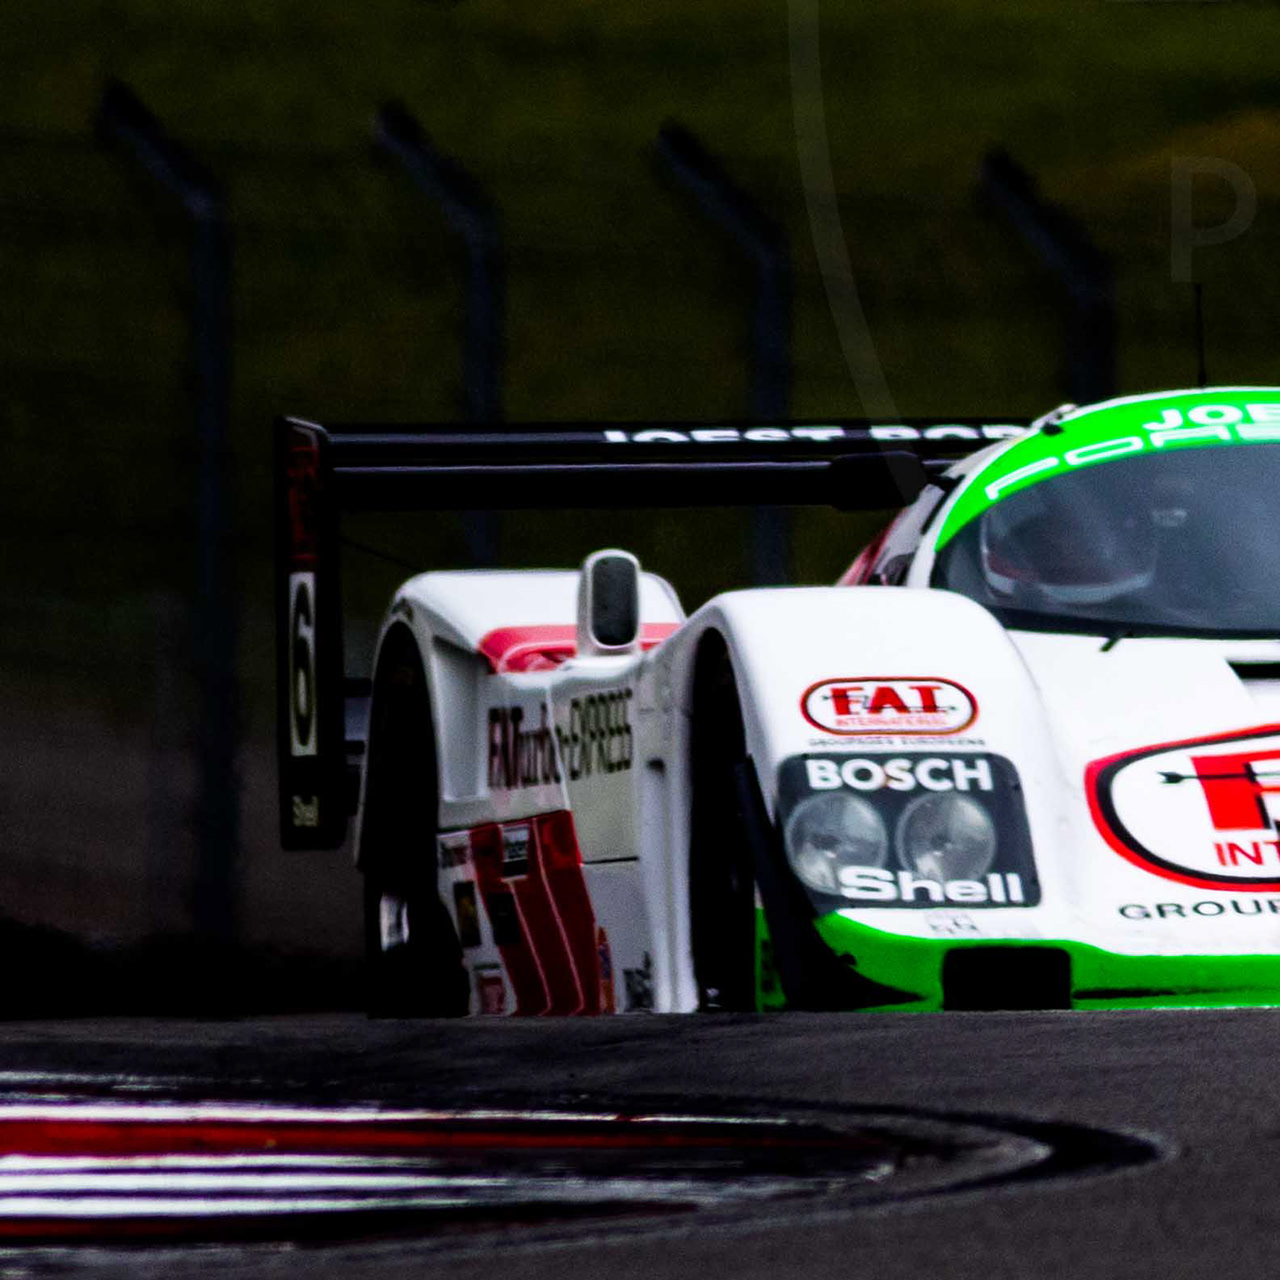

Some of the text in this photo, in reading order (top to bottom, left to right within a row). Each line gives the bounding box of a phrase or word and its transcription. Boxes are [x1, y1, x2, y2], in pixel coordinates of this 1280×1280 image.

[296, 580, 313, 748] 6
[805, 758, 994, 792] BOSCH
[839, 865, 1024, 903] Shell
